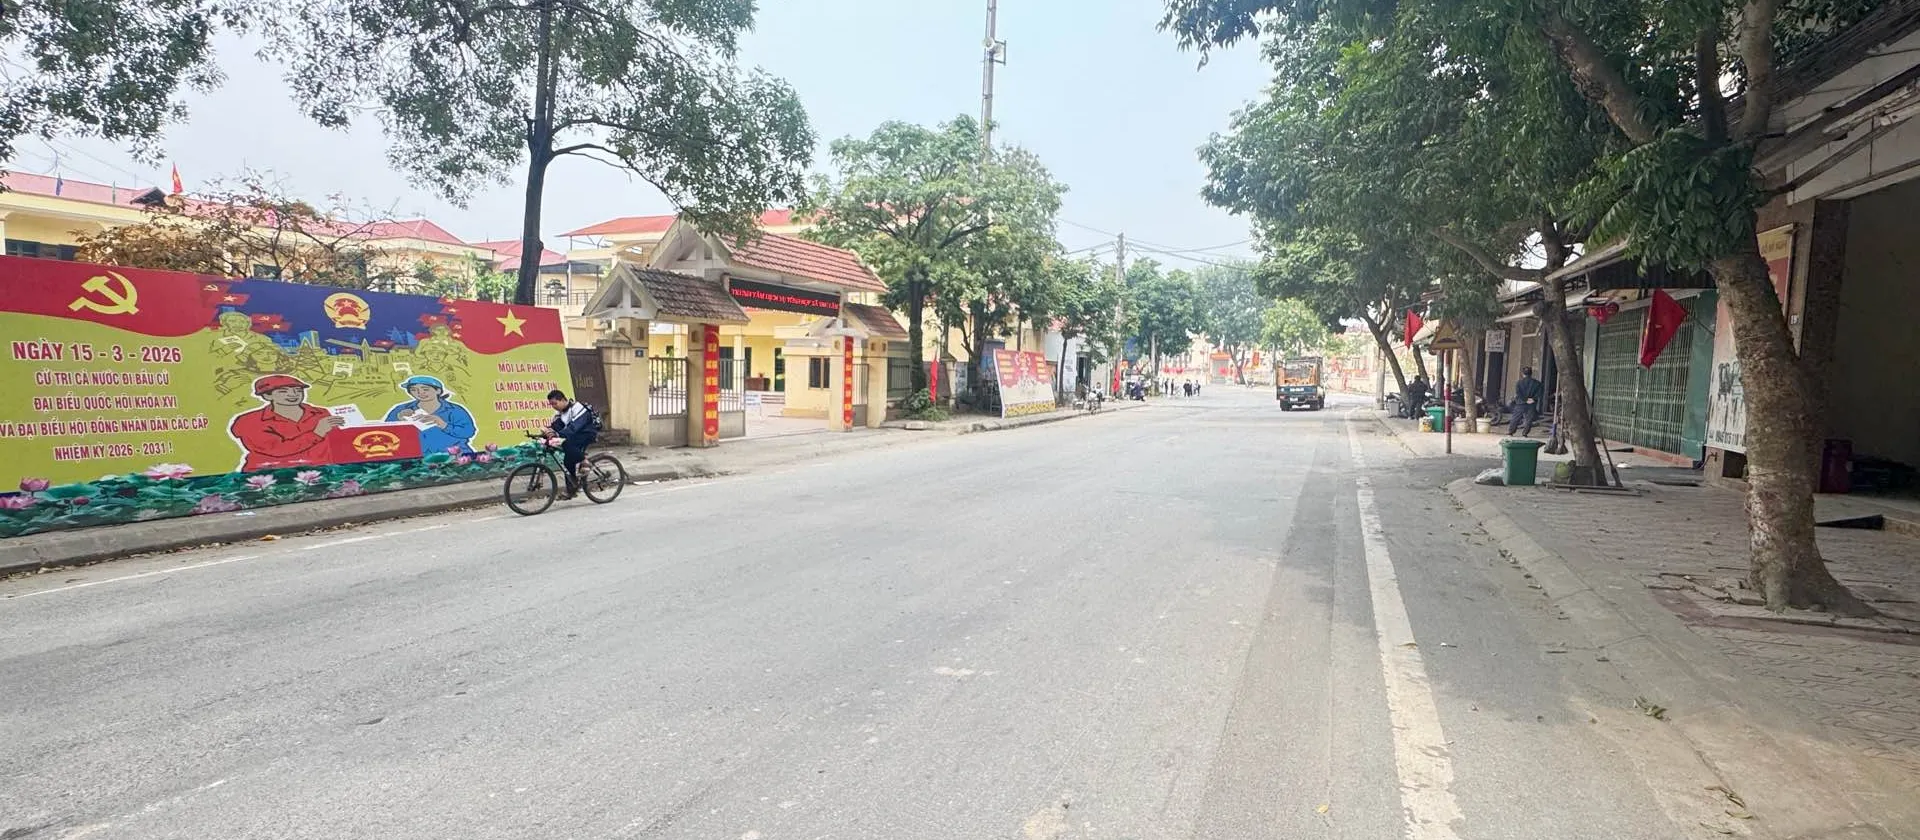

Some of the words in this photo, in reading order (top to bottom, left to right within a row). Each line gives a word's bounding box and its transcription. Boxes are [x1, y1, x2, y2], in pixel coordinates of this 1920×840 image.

[13, 338, 63, 361] NGÀY
[71, 343, 93, 361] 15
[112, 345, 123, 362] 3
[142, 346, 182, 363] 2026
[36, 369, 51, 386] CỬ
[55, 372, 71, 386] TRI
[75, 369, 90, 386] CẢ
[92, 370, 119, 386] NƯỚC
[122, 372, 133, 386] ĐI
[135, 369, 154, 386] BẦU
[157, 369, 169, 386] CỬ
[34, 397, 52, 413] ĐẠI
[56, 391, 81, 410] BIỂU
[84, 392, 112, 411] QUỐC
[115, 393, 133, 412] HỘI
[135, 393, 161, 409] KHÓA
[162, 396, 177, 409] XVI
[0, 421, 15, 438] VÀ
[18, 424, 37, 440] ĐẠI
[41, 417, 66, 436] BIỂU
[69, 420, 89, 437] HỘI
[90, 416, 119, 434] ĐỒNG
[121, 416, 148, 432] NHÂN
[150, 415, 169, 431] DÂN
[171, 414, 189, 430] CÁC
[191, 413, 209, 430] CẤP
[55, 442, 90, 463] NHIỆM
[92, 441, 105, 458] KỲ
[109, 444, 134, 457] 2026
[143, 442, 167, 456] 2031
